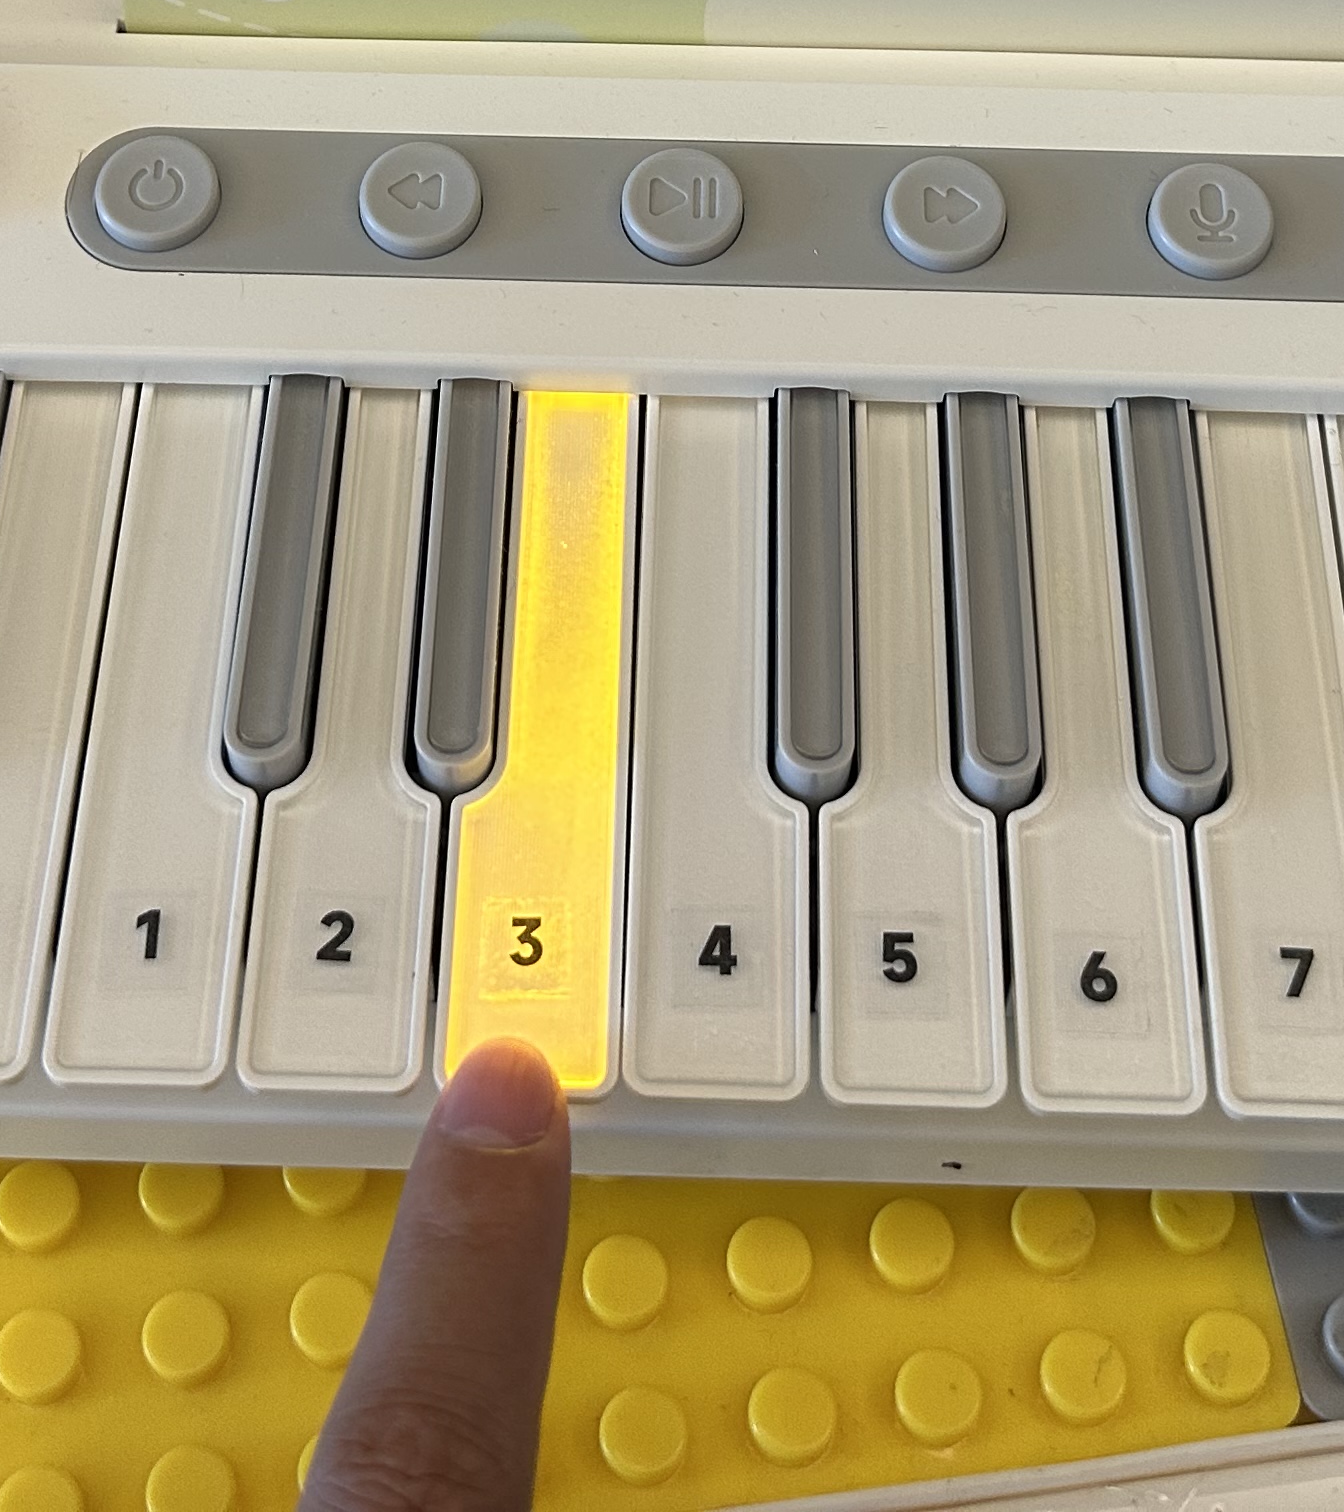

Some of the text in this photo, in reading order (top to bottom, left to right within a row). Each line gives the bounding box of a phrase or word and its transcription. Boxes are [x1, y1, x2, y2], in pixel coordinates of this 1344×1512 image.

[135, 909, 161, 960] 1
[315, 910, 355, 963] 2
[509, 916, 544, 967] 3
[698, 925, 738, 976] 4
[882, 931, 918, 984] 5
[1080, 951, 1118, 1004] 6
[1279, 946, 1315, 999] 7
